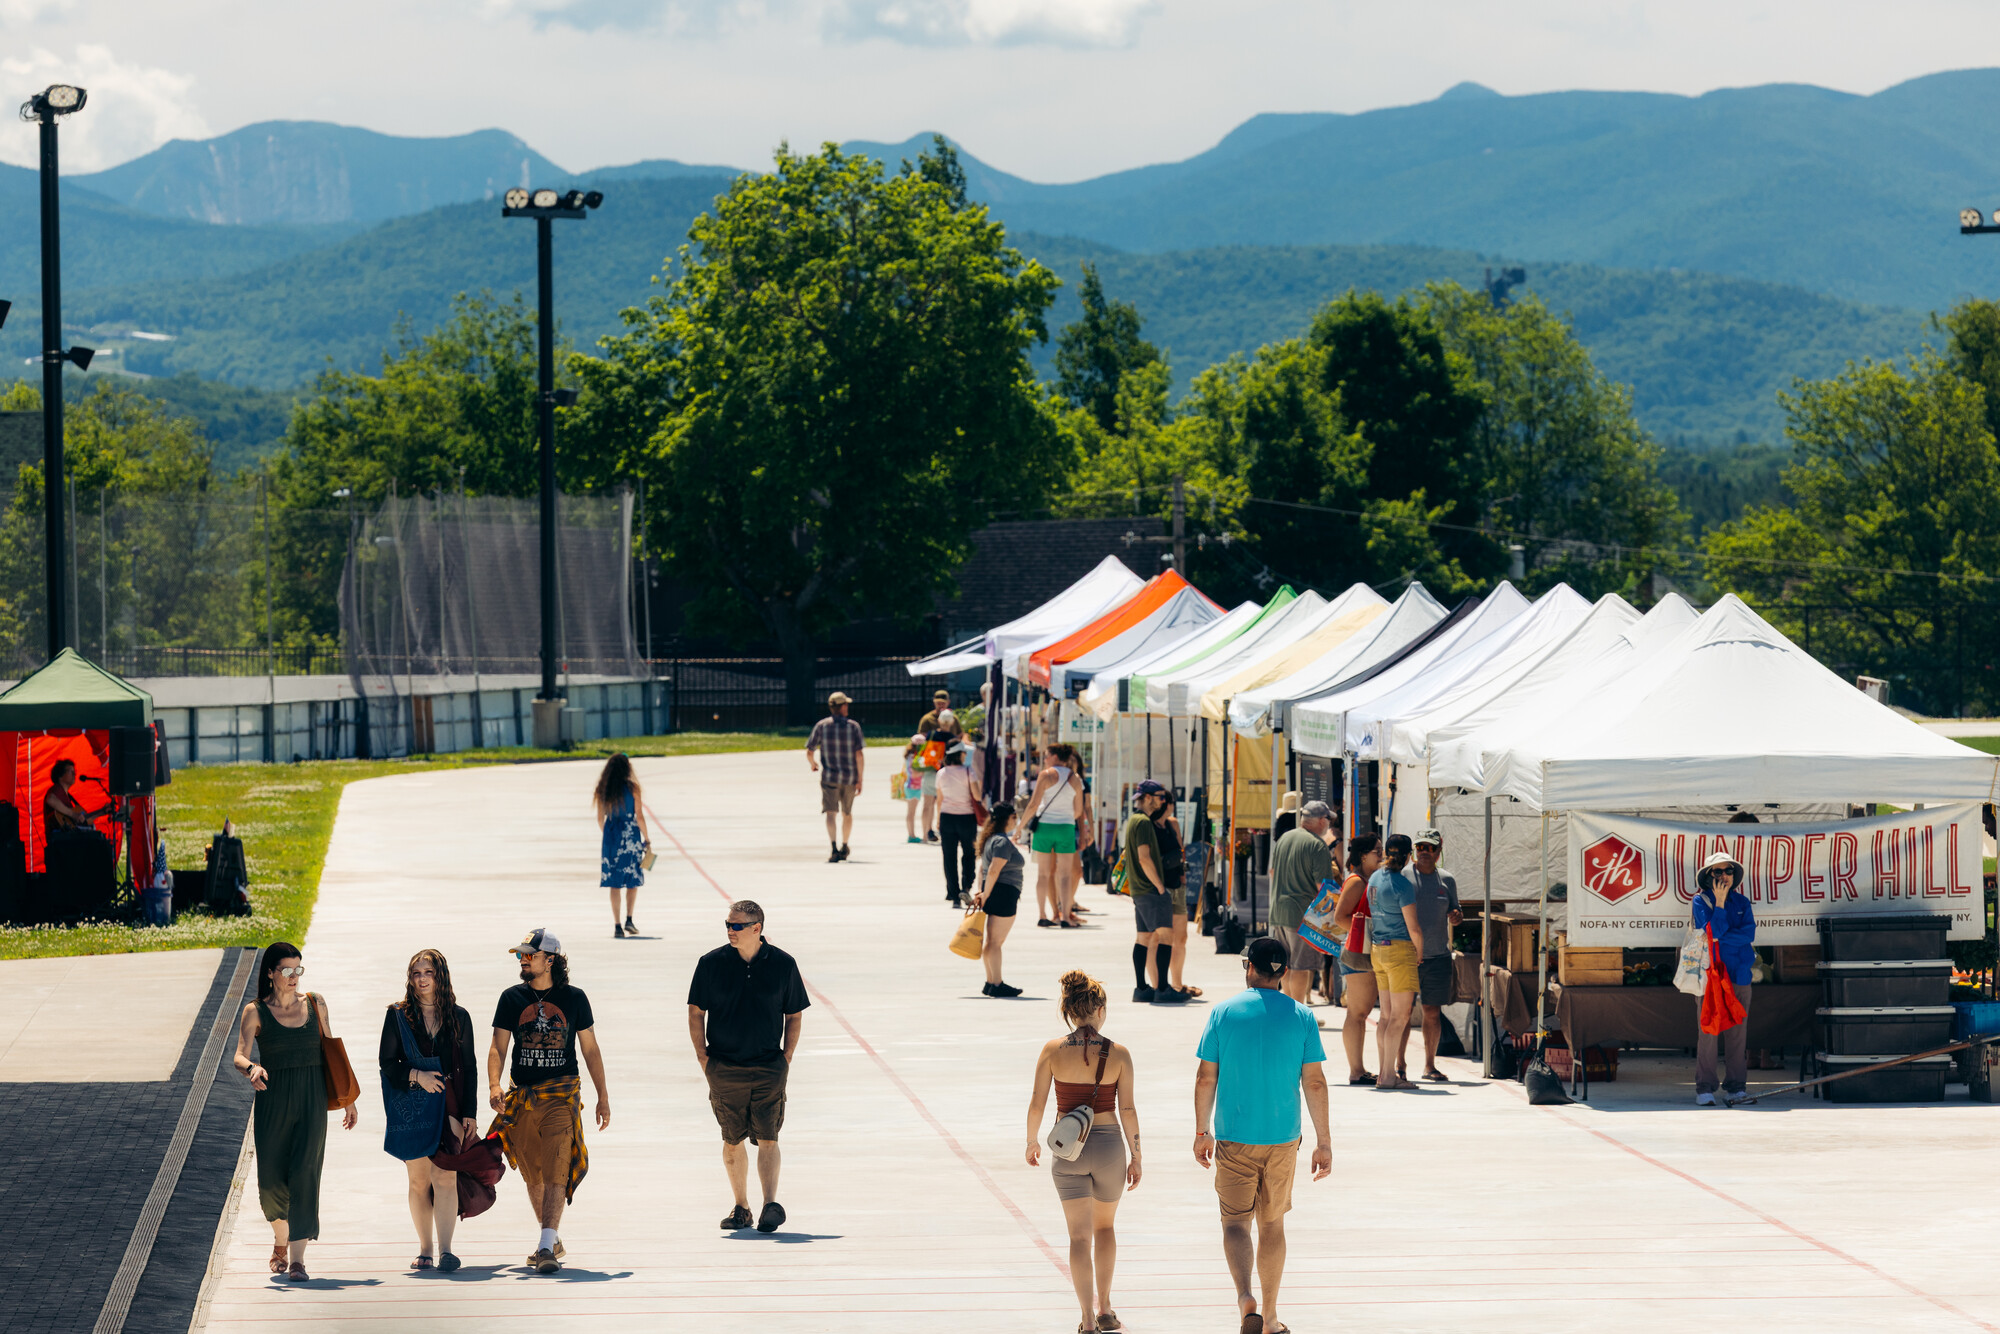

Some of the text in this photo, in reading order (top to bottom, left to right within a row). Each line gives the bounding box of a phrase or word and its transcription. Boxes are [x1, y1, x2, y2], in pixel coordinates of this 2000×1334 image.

[1872, 823, 1971, 899] HILL
[1580, 920, 1626, 929] NOFA-NY
[1629, 920, 1684, 929] CERTIFIED
[1309, 931, 1339, 952] SARATOG
[521, 1049, 564, 1058] SILVER CITY
[537, 1058, 567, 1067] MEXICO
